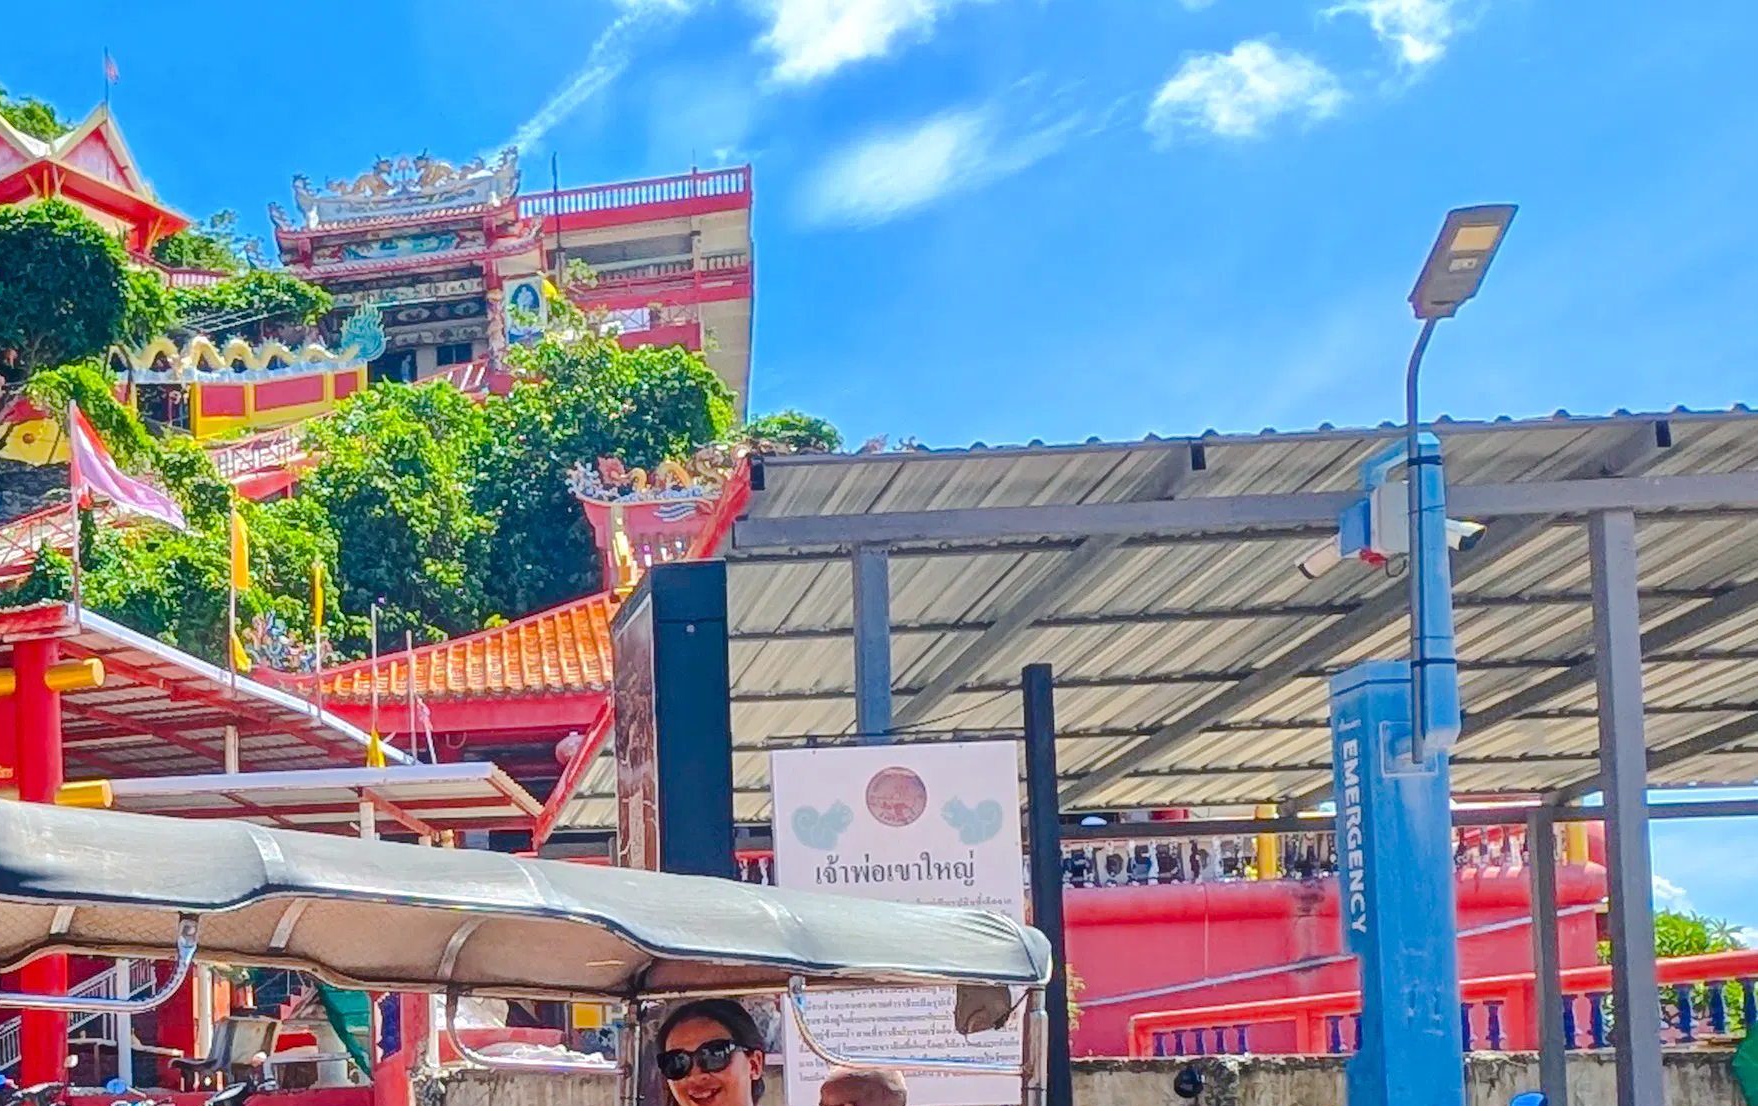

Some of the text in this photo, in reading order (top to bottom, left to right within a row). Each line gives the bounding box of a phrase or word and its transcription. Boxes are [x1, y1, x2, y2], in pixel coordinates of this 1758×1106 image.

[815, 850, 976, 887] เจ้าพ่อเขาใหญ่
[1343, 739, 1367, 934] EMERGENCY
